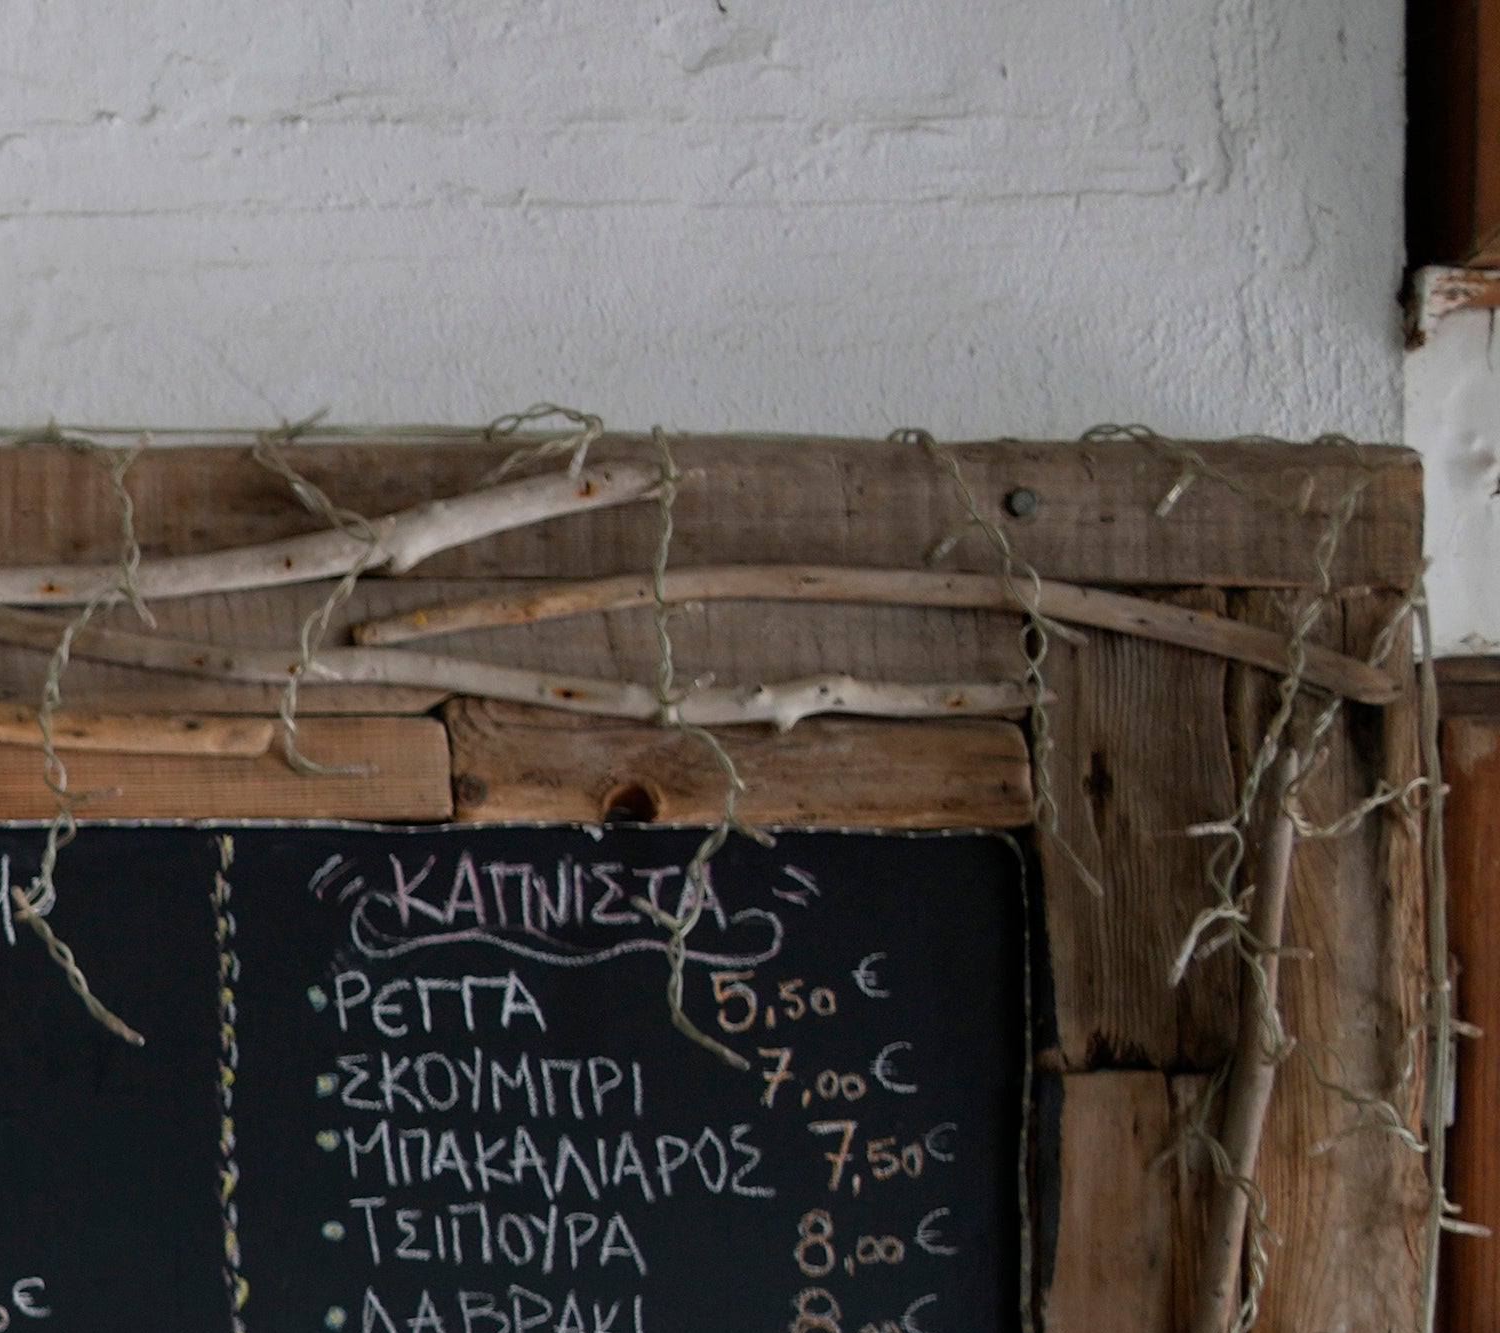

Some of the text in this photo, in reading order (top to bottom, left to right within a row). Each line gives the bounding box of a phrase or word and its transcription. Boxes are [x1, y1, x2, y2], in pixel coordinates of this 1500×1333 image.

[335, 969, 546, 1036] ΡΕΓΓΑ
[336, 1048, 644, 1119] ΣΚΟΥΜΠΡΙ
[344, 1119, 776, 1202] ΜΠΑΚΑΛΙΑΡΟΣ
